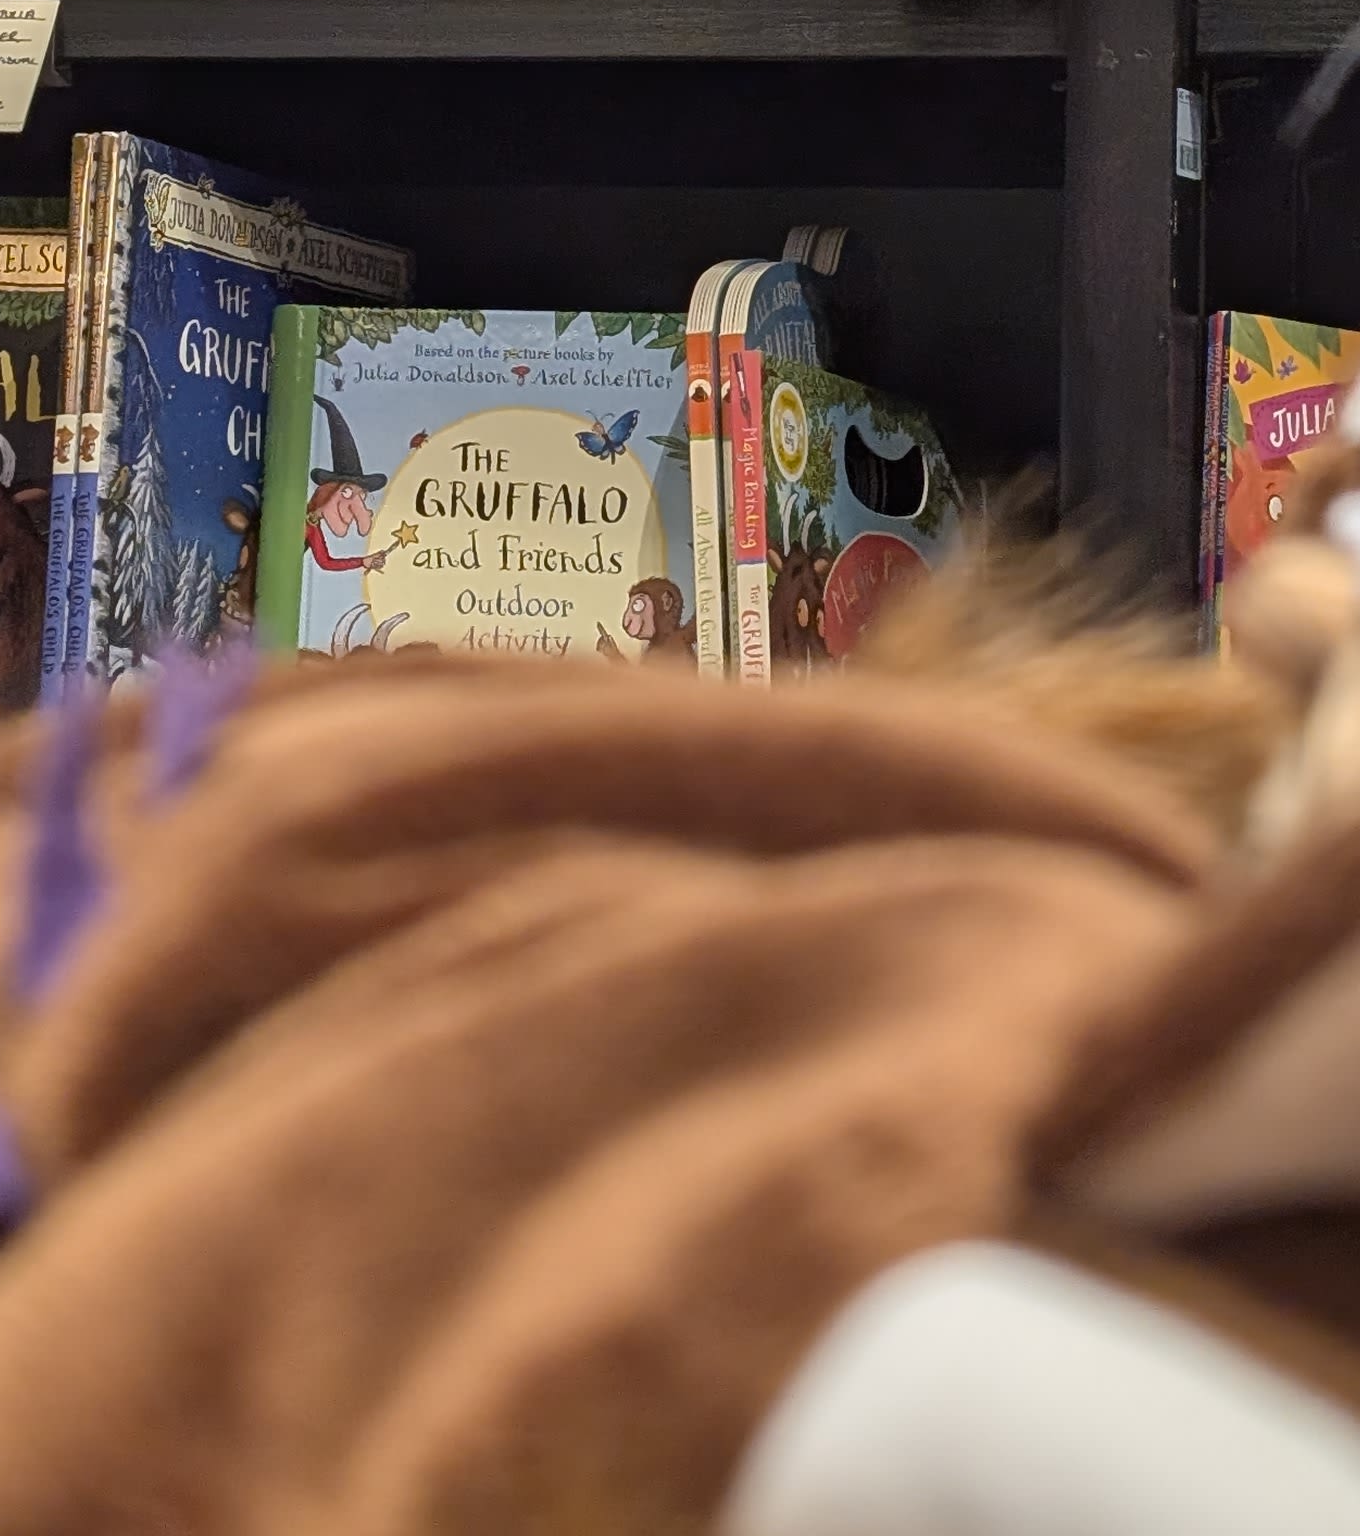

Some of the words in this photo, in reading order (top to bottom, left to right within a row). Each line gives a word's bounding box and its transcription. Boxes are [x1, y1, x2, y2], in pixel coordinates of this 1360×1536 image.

[167, 196, 206, 234] JULIA
[208, 208, 284, 259] DONALDSON
[297, 236, 333, 268] AXEL
[36, 243, 66, 273] SC
[213, 277, 253, 319] THE
[414, 343, 454, 360] Based
[457, 346, 475, 360] on
[478, 344, 500, 360] the
[502, 344, 553, 363] picture
[554, 346, 596, 362] books
[598, 346, 615, 365] by
[353, 361, 400, 385] Julia
[404, 363, 509, 386] Donaldson
[530, 366, 578, 387] Axel
[583, 367, 674, 390] Scheffler
[226, 404, 262, 462] CH
[1268, 396, 1337, 449] JULIA
[451, 441, 511, 474] THE
[737, 425, 759, 477] Magic
[415, 477, 630, 525] GRUFFALO
[695, 505, 715, 527] All
[739, 480, 762, 550] Painting
[412, 529, 482, 570] and
[496, 532, 625, 575] Friends
[695, 532, 715, 584] About
[456, 584, 576, 618] Outdoor
[698, 589, 717, 613] the
[459, 624, 573, 657] Activity
